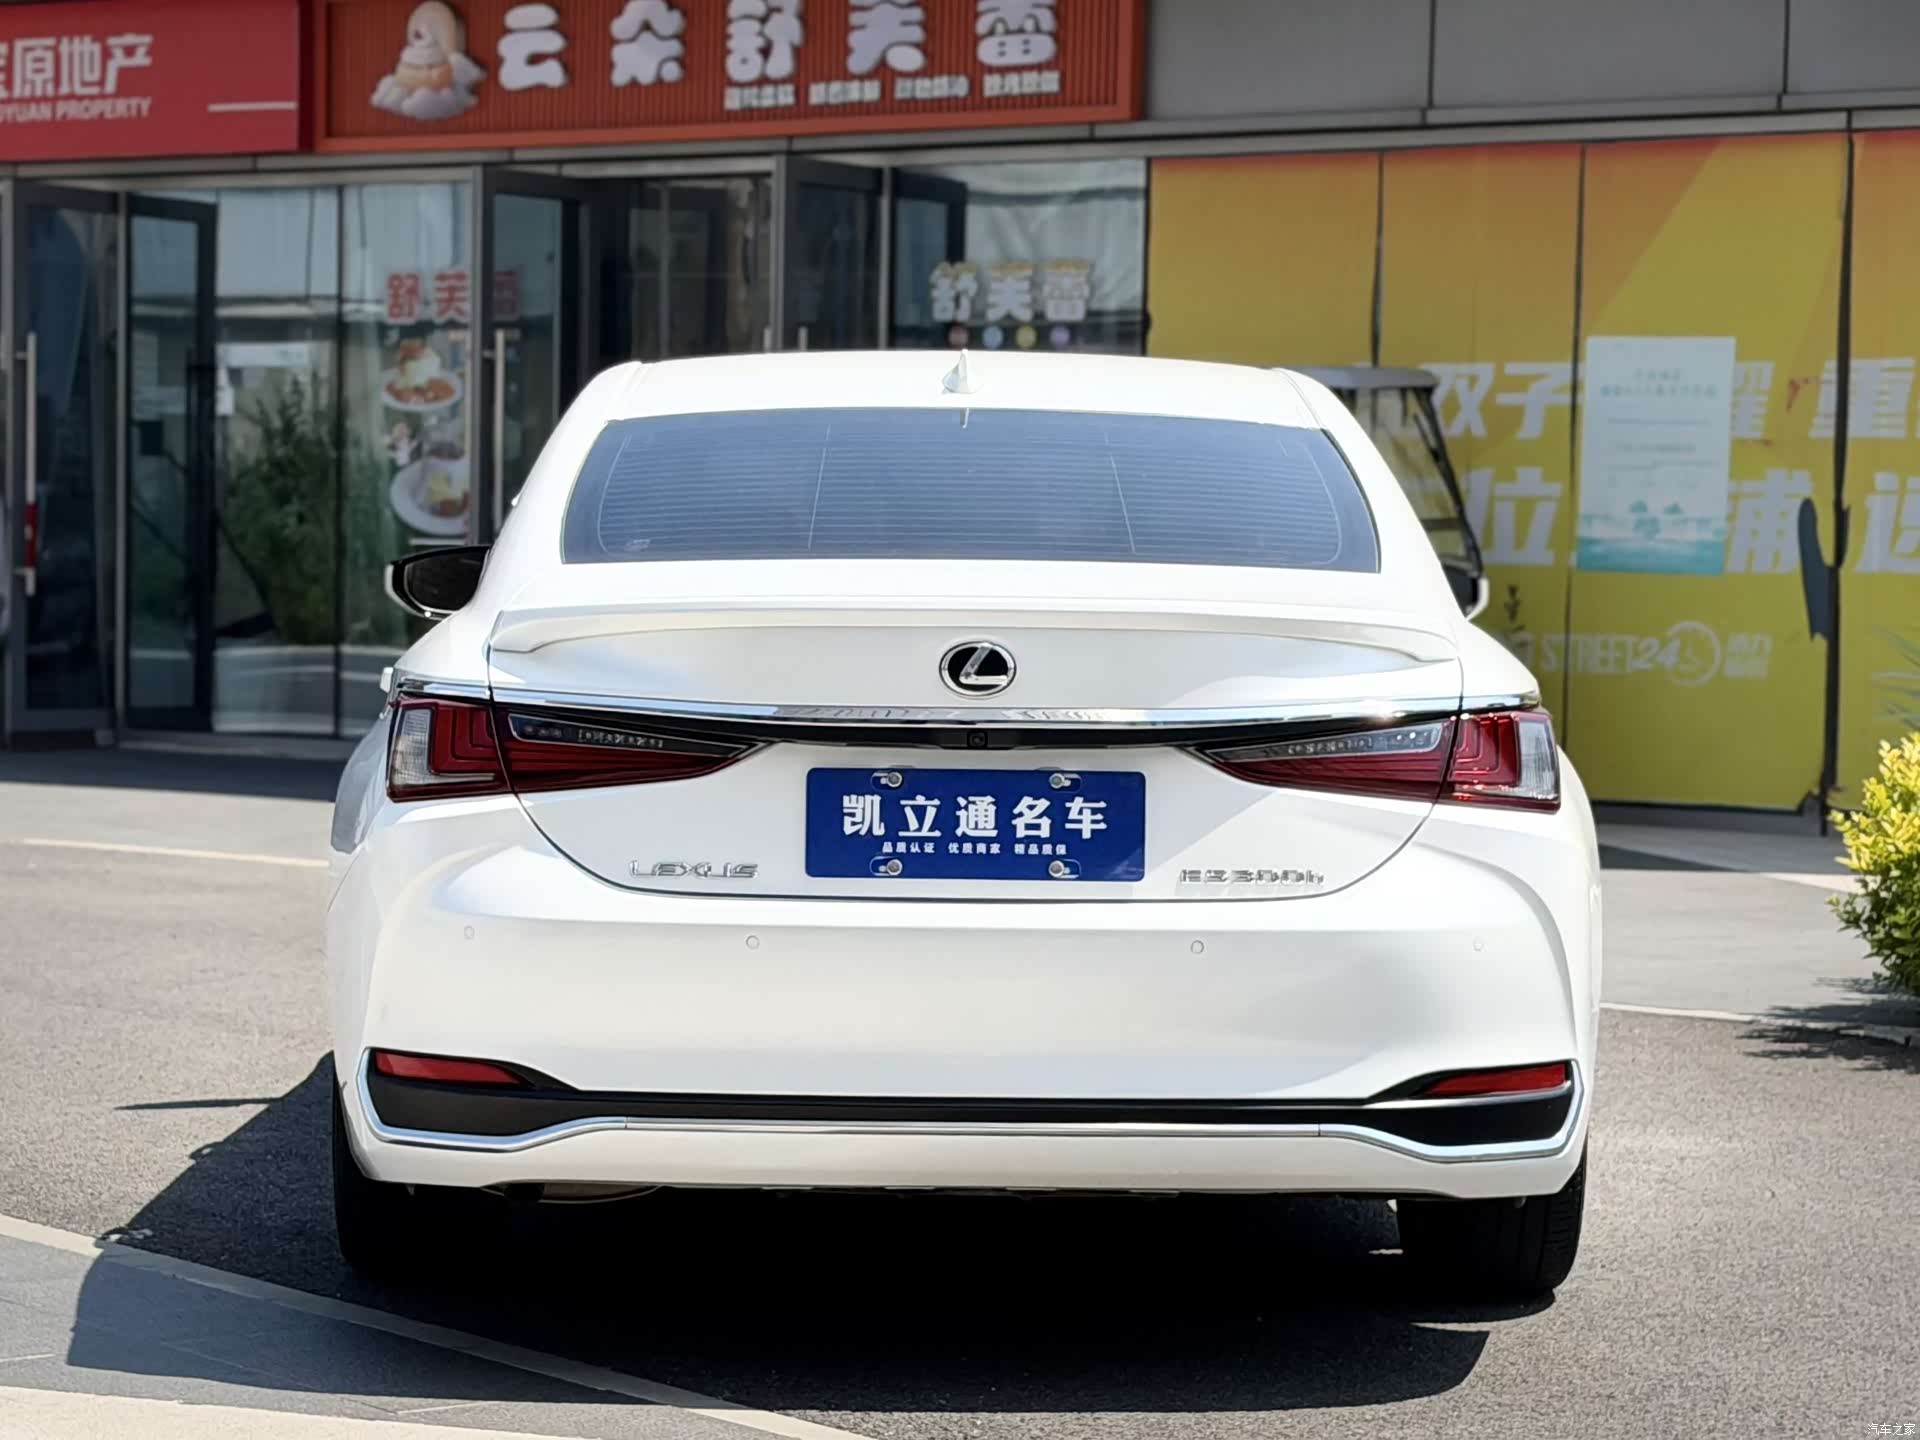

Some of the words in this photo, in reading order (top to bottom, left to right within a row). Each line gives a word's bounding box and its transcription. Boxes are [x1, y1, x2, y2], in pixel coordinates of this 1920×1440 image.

[0, 101, 53, 123] YUAN
[56, 96, 151, 120] PROPERTY
[1808, 357, 1920, 440] 重
[842, 794, 1108, 840] 凯立通名车
[629, 859, 759, 880] LEXUS
